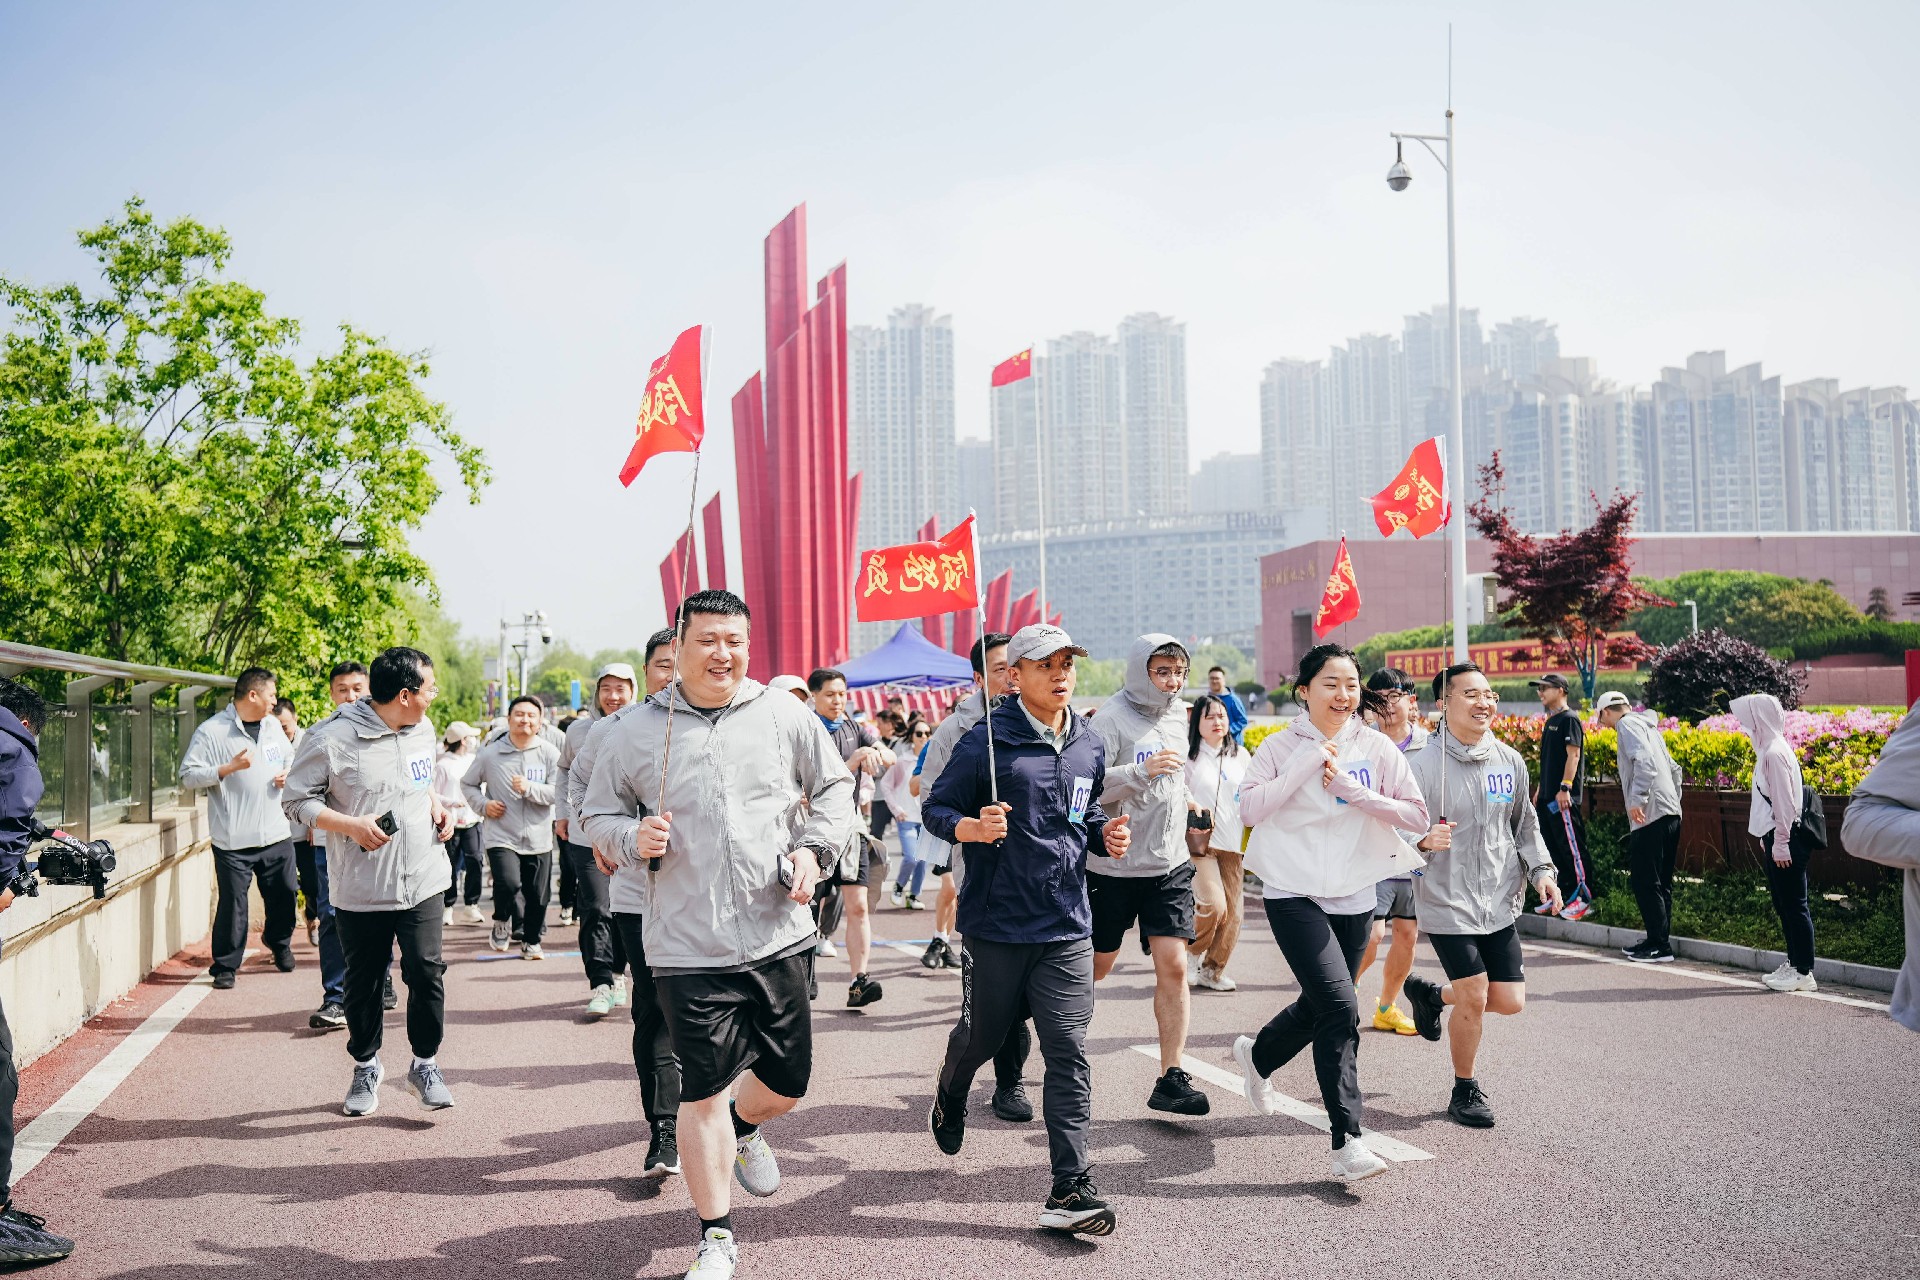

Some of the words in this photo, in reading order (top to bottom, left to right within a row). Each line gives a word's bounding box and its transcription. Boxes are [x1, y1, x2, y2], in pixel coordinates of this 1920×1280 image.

[1226, 512, 1284, 529] Hilton
[411, 757, 433, 781] 039
[527, 769, 543, 781] 011
[1488, 774, 1513, 795] 013
